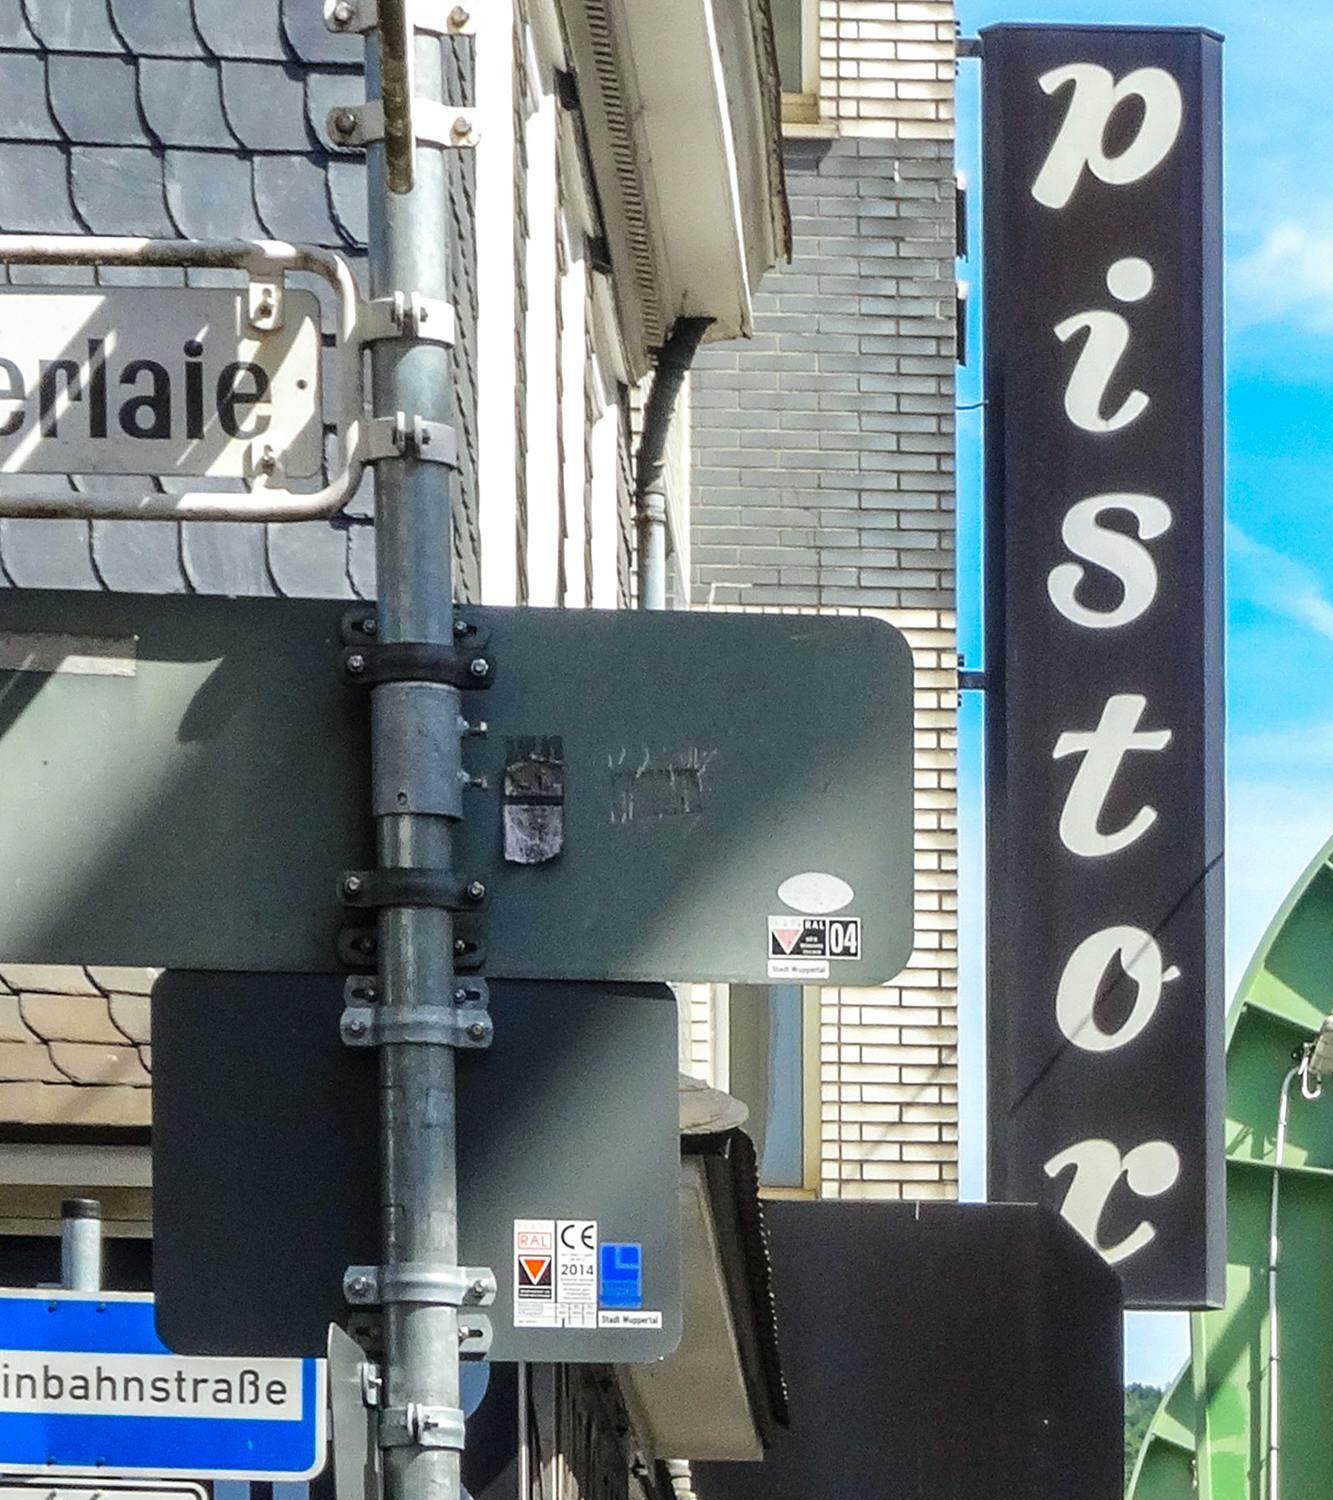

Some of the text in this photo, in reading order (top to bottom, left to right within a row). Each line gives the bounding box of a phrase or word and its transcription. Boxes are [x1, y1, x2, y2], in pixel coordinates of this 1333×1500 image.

[1031, 62, 1182, 1265] pistor
[830, 922, 858, 954] 04
[561, 1224, 595, 1250] CE
[560, 1263, 595, 1276] 2014
[3, 1363, 287, 1406] inbahnstraße
